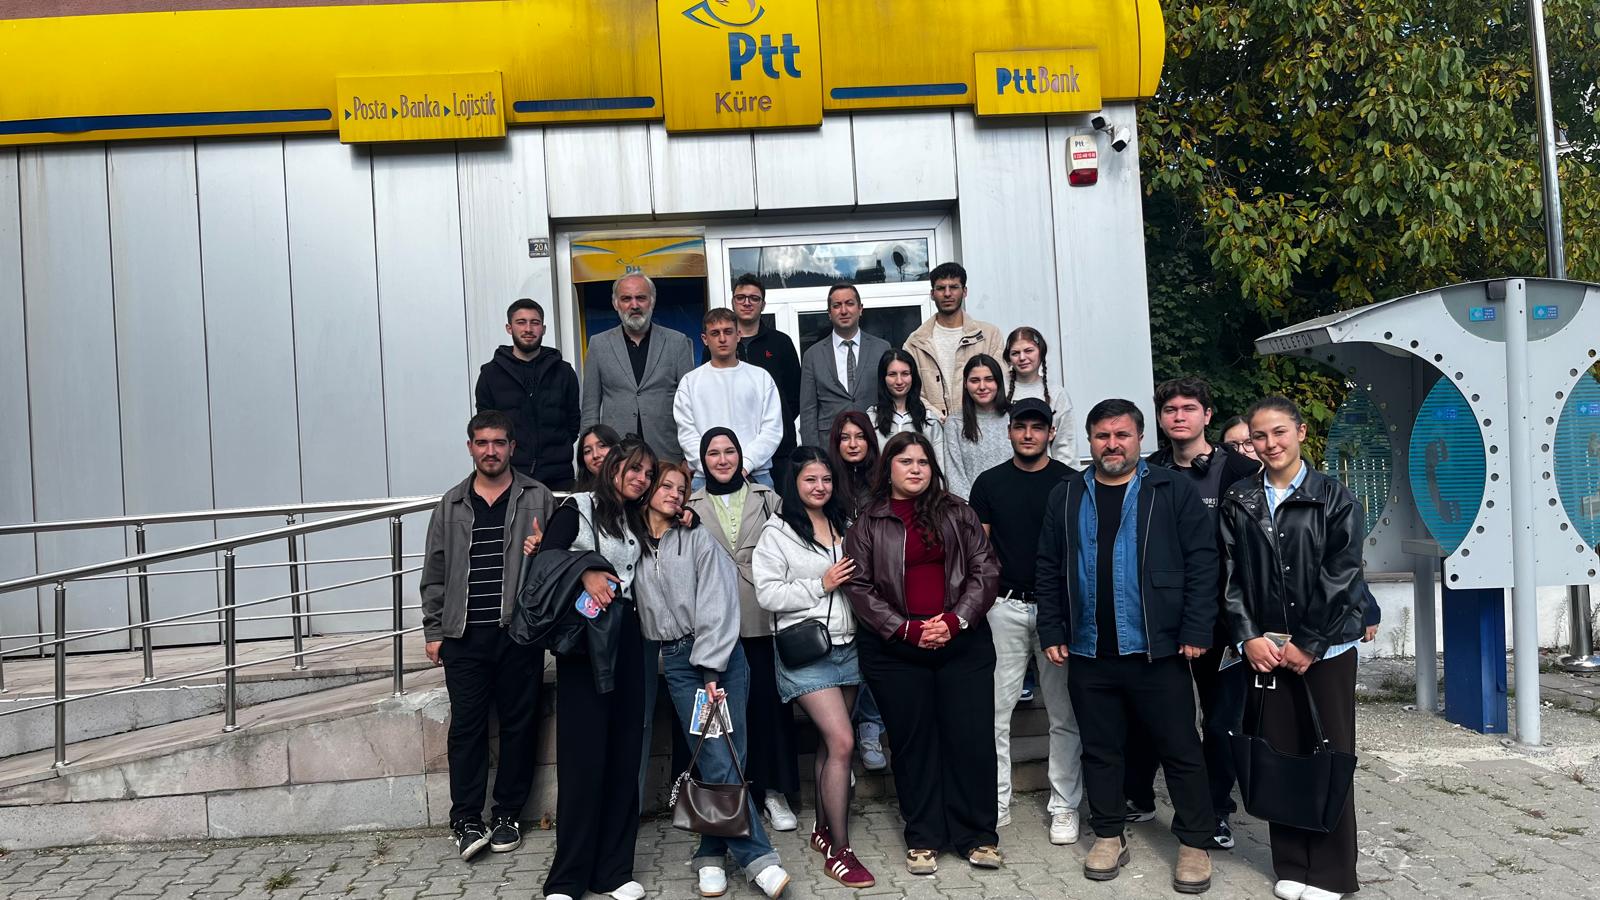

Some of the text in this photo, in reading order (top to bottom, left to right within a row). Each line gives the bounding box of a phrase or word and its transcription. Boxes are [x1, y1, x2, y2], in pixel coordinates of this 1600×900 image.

[728, 32, 801, 80] Ptt
[353, 92, 496, 120] Posta Banka Lojistik
[715, 91, 772, 113] Küre
[1274, 333, 1315, 351] TELEFON
